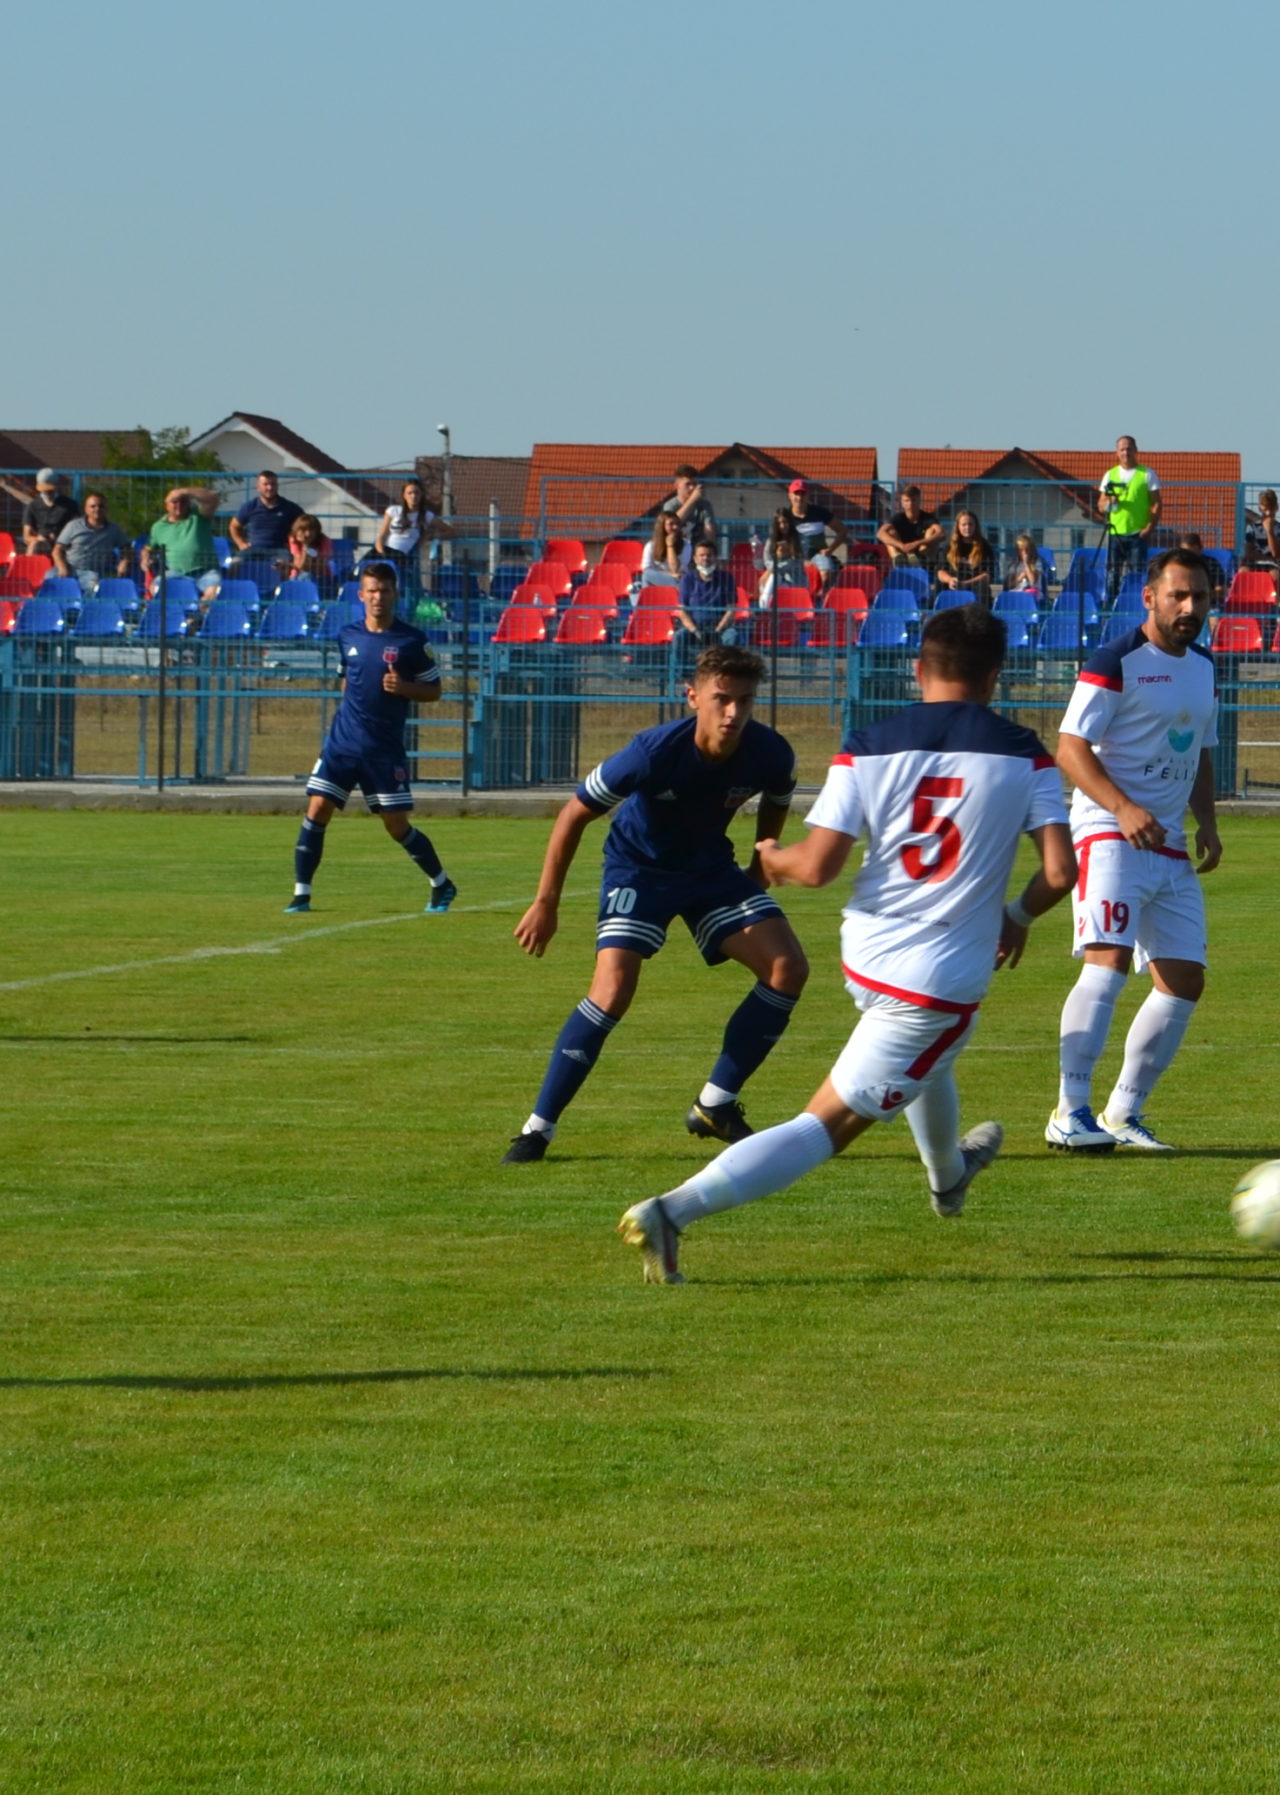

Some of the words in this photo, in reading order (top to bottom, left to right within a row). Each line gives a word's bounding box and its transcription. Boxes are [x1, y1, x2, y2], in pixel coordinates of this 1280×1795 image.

[899, 775, 963, 885] 5
[606, 887, 637, 914] 10
[1101, 899, 1129, 934] 19
